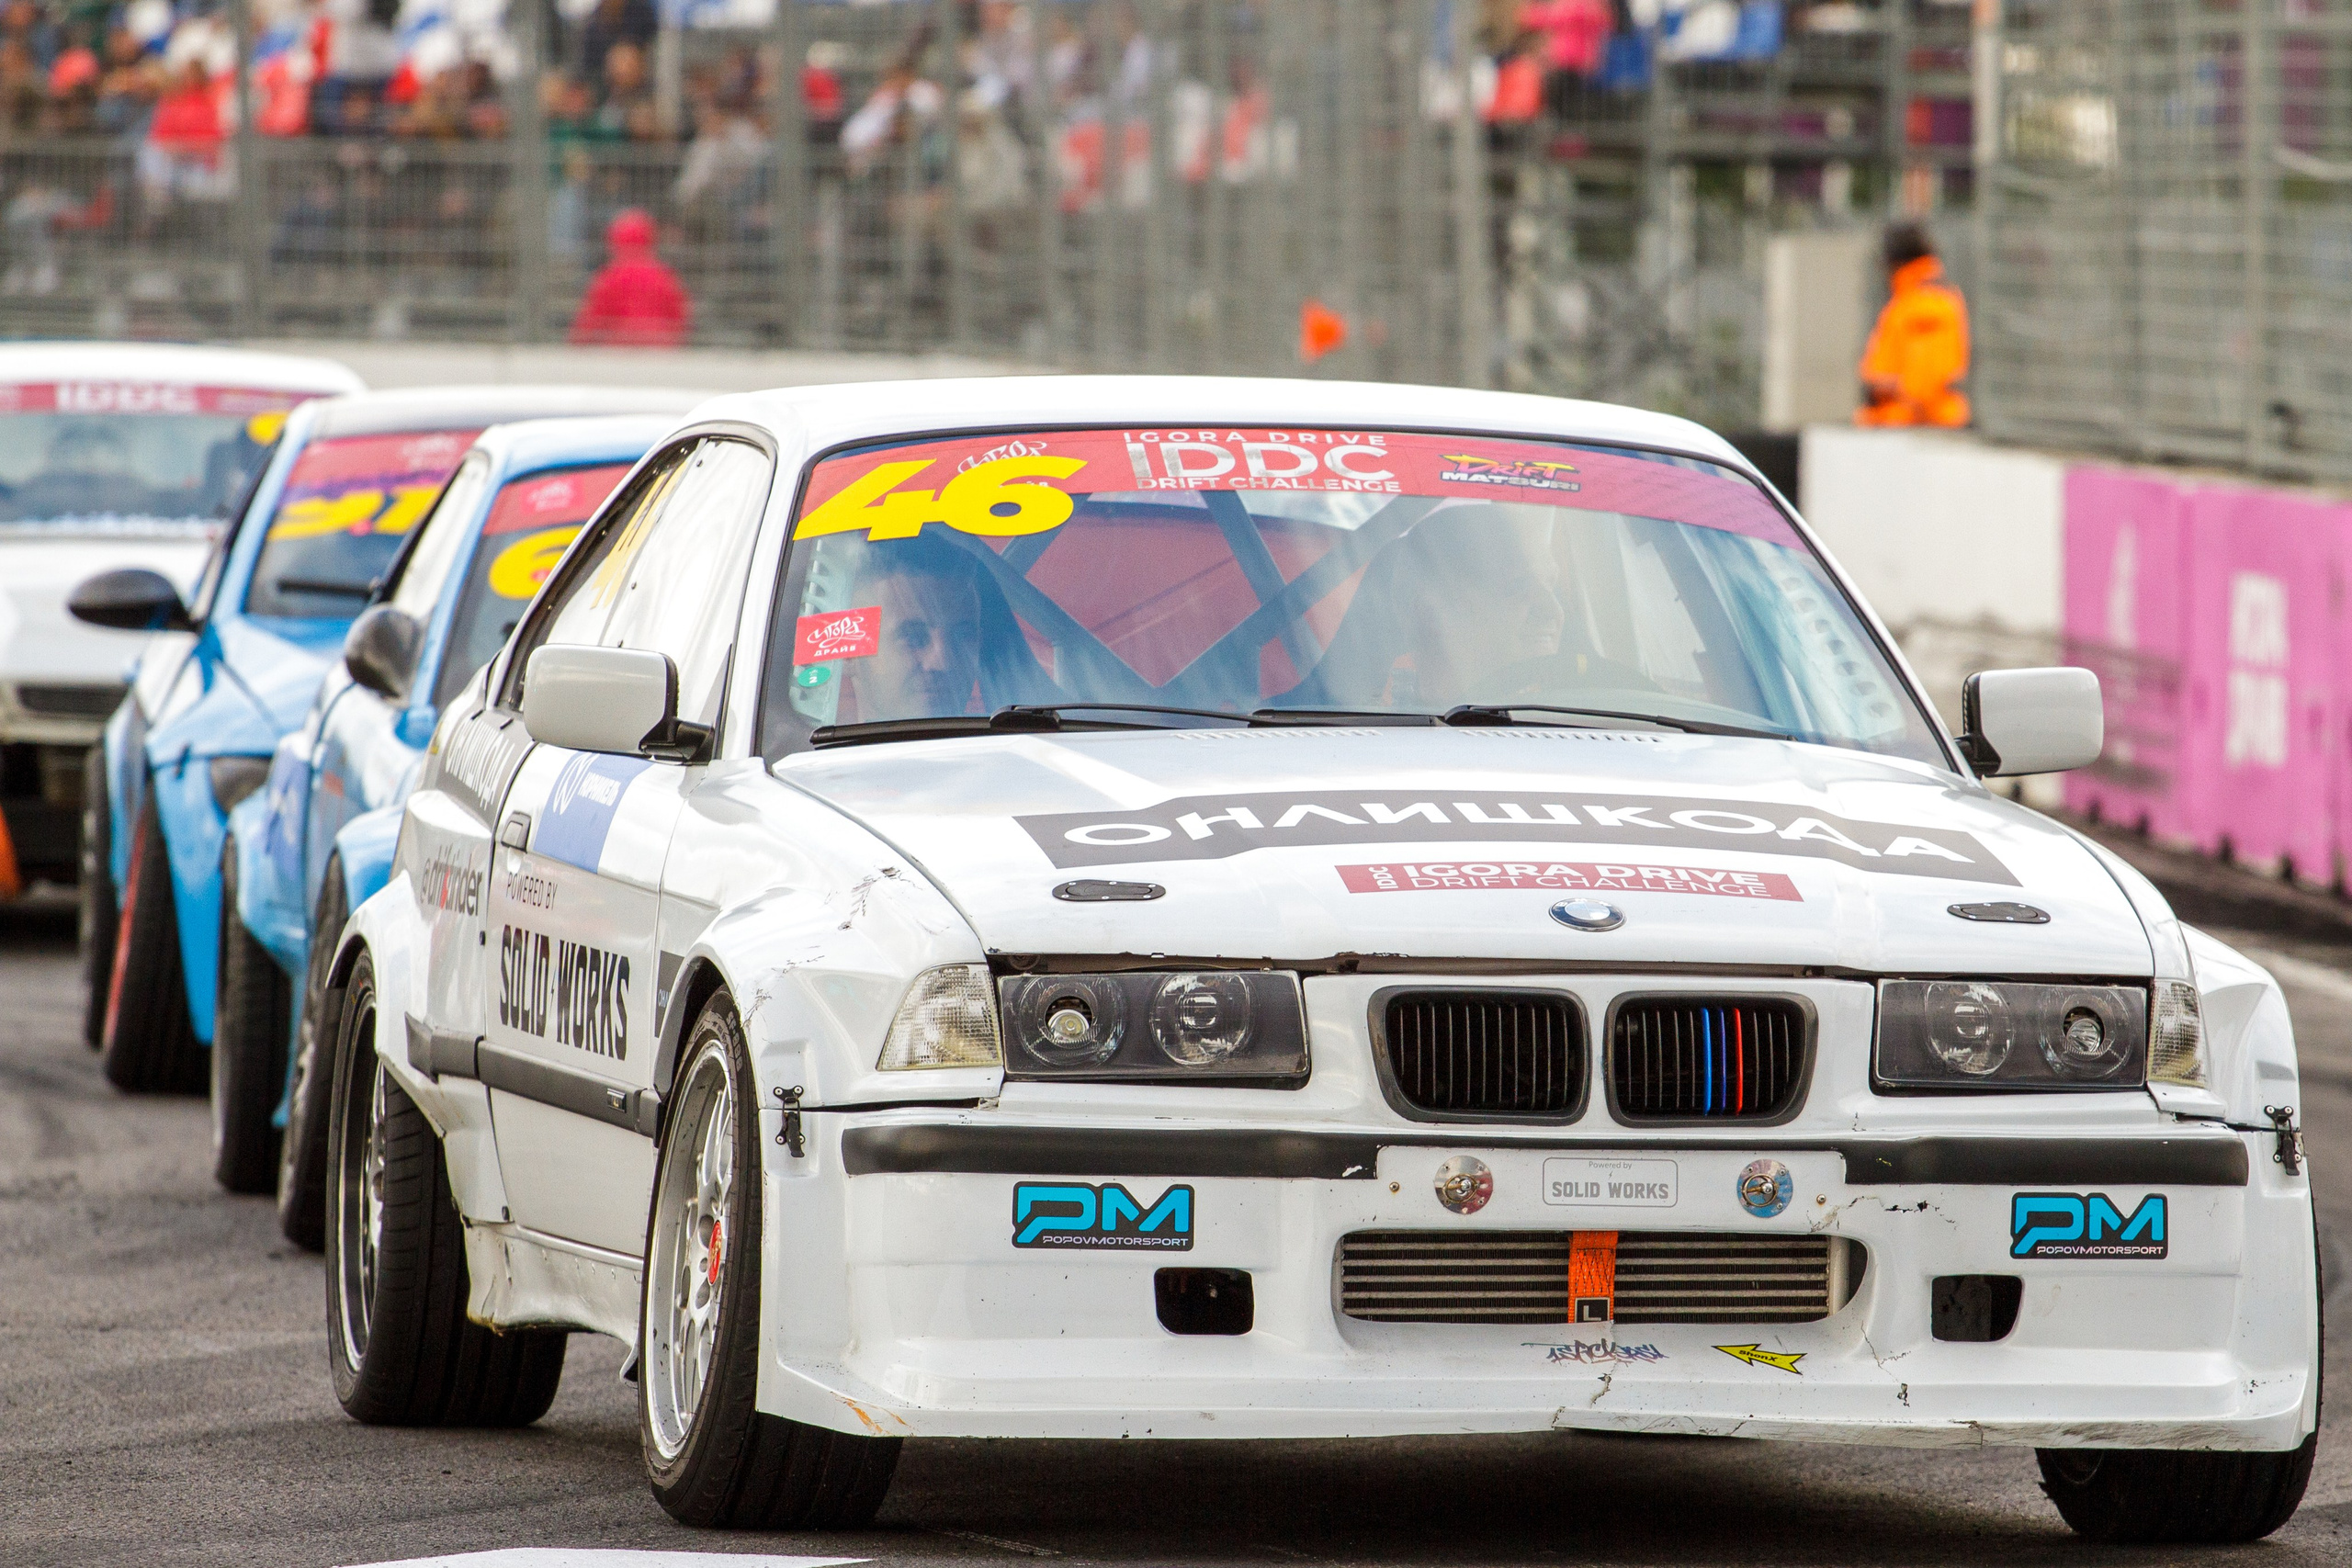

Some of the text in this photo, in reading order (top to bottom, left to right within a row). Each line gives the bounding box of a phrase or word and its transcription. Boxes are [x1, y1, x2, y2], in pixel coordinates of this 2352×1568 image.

[1124, 432, 1387, 446] IGORA DRIVE
[1126, 442, 1395, 480] IDDC
[1136, 477, 1402, 492] DRIFT CHALLENGE
[1441, 471, 1580, 491] MATSURI
[793, 455, 1088, 541] 46
[814, 645, 857, 657] ДРАЙВ
[1368, 866, 1399, 889] IDDC
[1403, 864, 1765, 886] IGORA DRIVE
[505, 872, 558, 911] POWERED BY
[1409, 876, 1771, 897] DRIFT CHALLENGE
[499, 923, 630, 1062] SOLID WORKS
[1589, 1161, 1633, 1170] Powered by
[1552, 1181, 1669, 1200] SOLID WORKS
[1016, 1186, 1190, 1244] PM
[2014, 1197, 2165, 1255] PM
[1042, 1235, 1189, 1247] POPOVMOTORSPORT
[2036, 1246, 2164, 1255] POPOVMOTORSPORT
